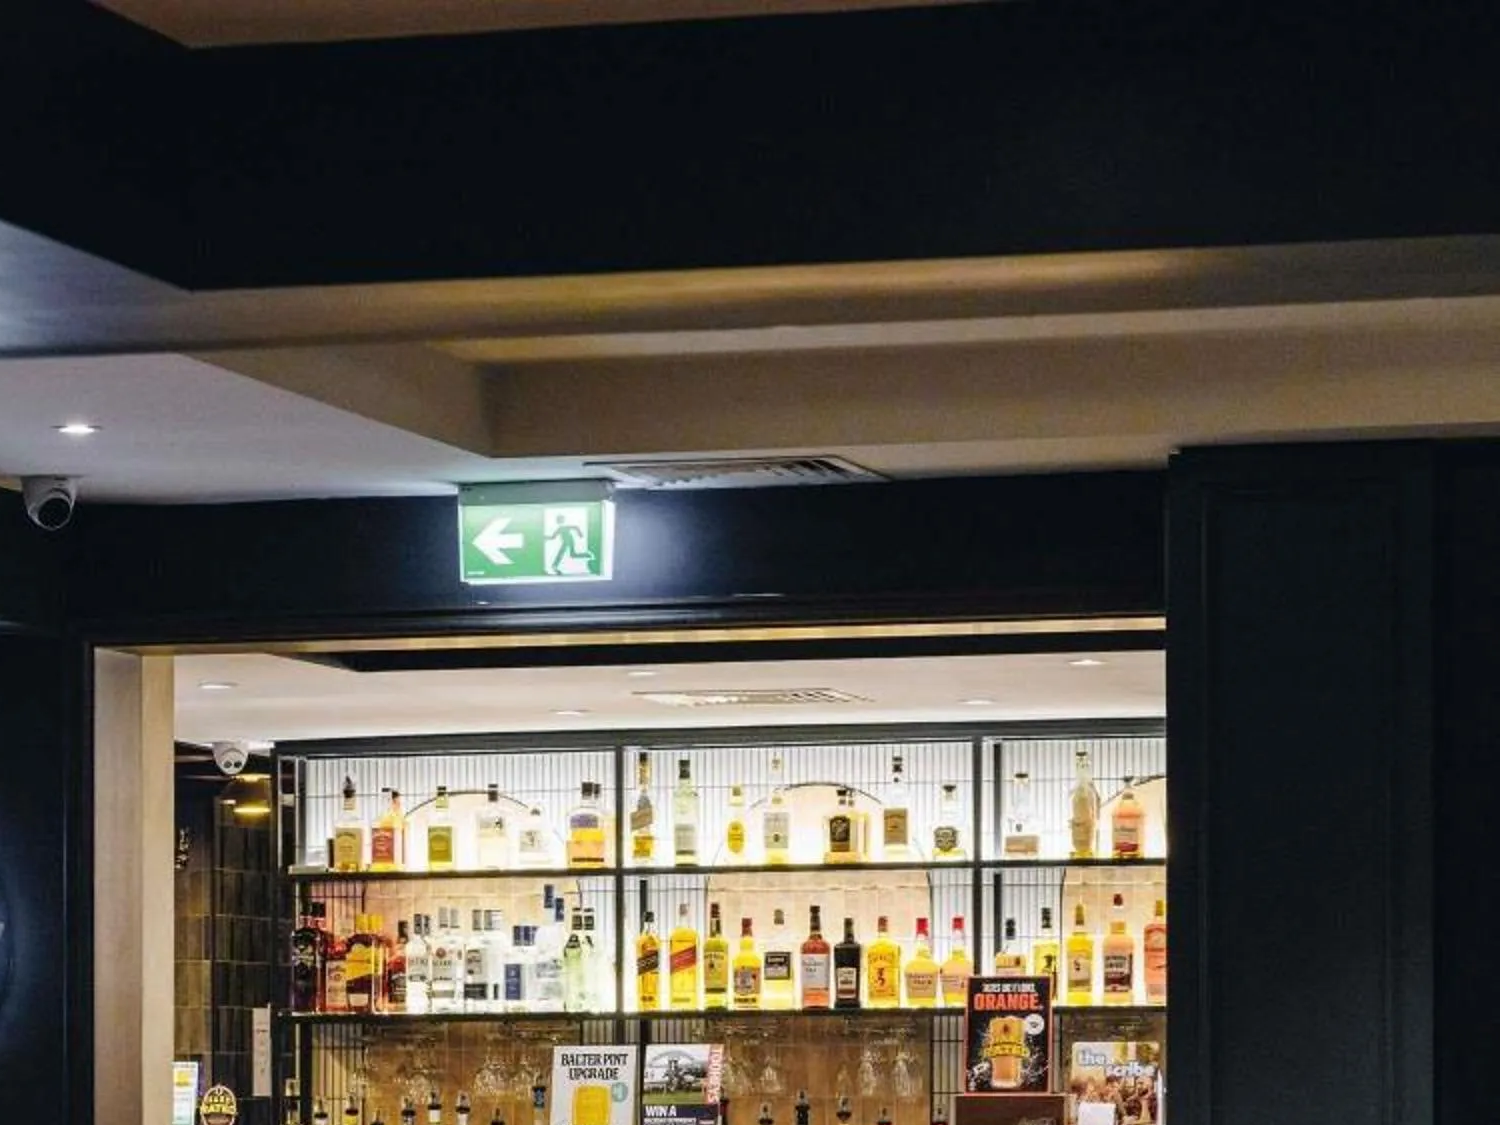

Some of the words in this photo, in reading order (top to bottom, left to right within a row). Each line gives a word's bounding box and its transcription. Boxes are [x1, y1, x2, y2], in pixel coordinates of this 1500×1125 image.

[604, 1052, 629, 1067] PINT
[568, 1067, 620, 1081] UPGRADE
[645, 1105, 667, 1117] WIN
